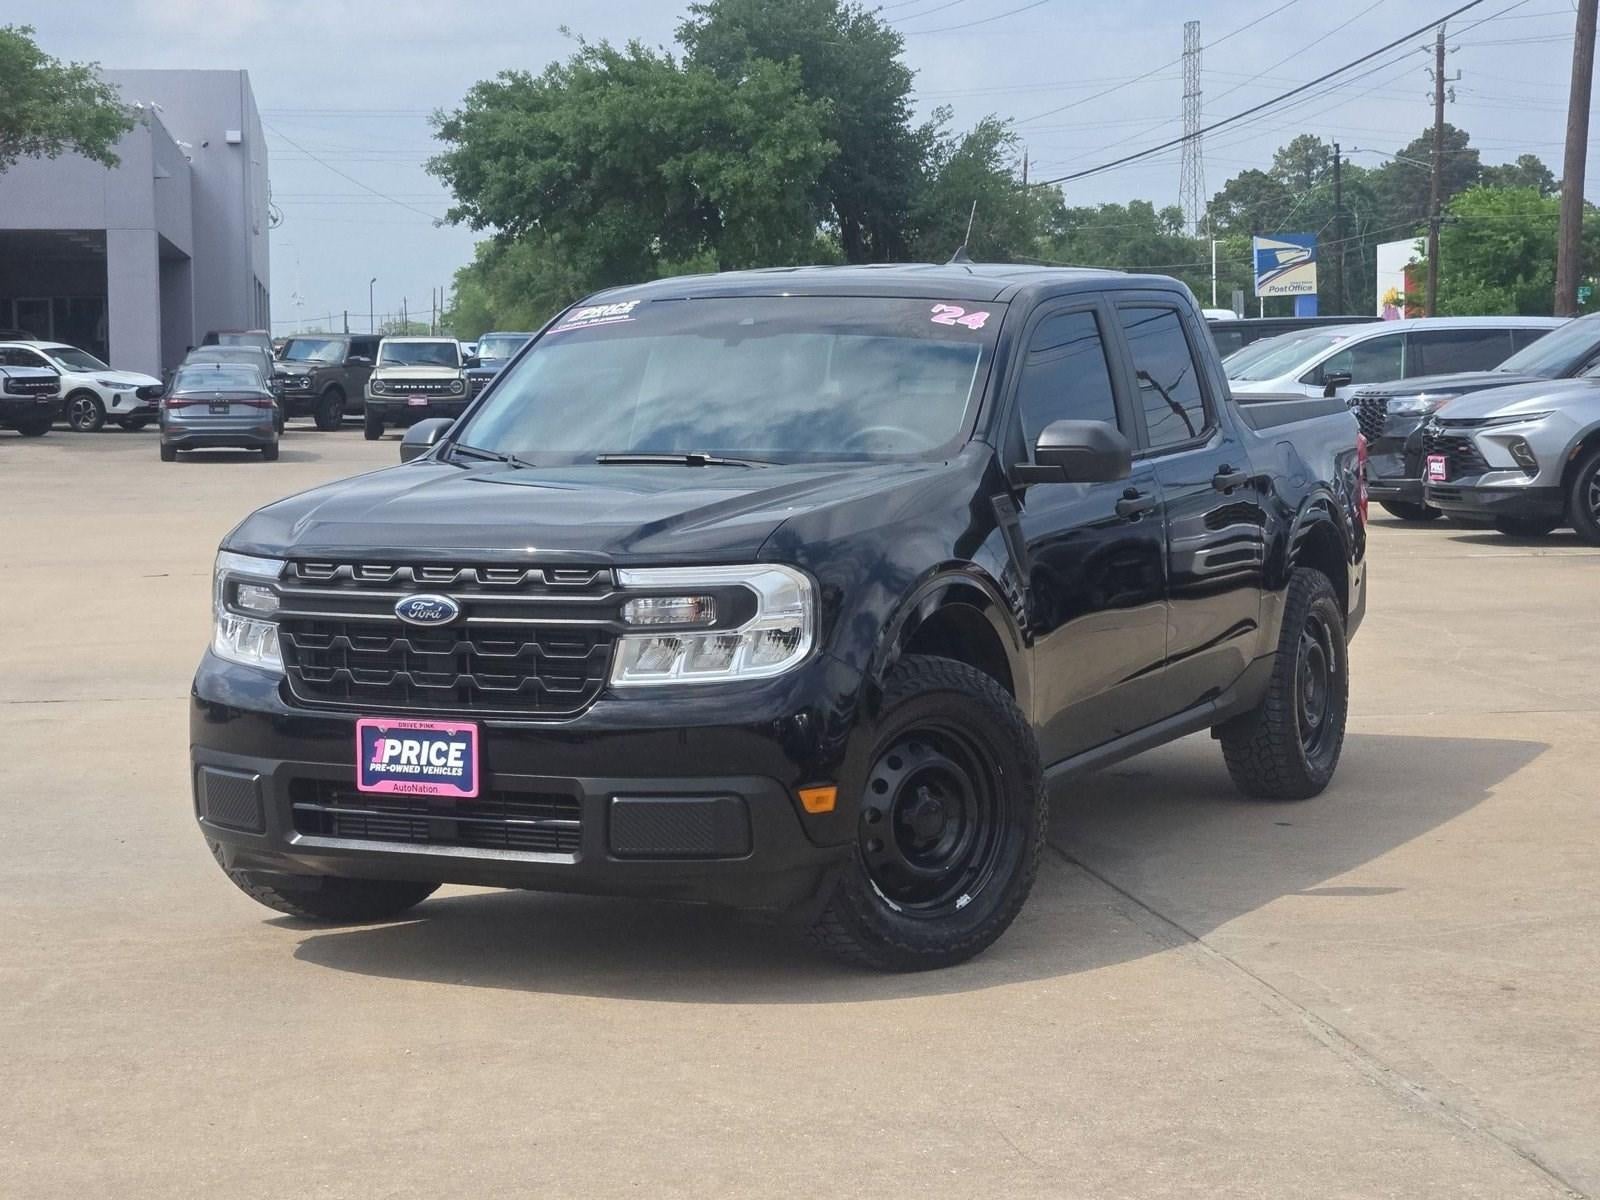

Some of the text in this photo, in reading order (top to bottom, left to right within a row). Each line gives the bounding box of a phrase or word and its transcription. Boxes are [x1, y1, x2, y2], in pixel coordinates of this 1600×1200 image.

[1268, 284, 1312, 293] Post Office
[408, 601, 443, 619] Ford
[372, 738, 466, 768] 1PRICE
[369, 763, 463, 776] PRE-OWNED VEHICLES
[393, 783, 438, 793] AutoNation
